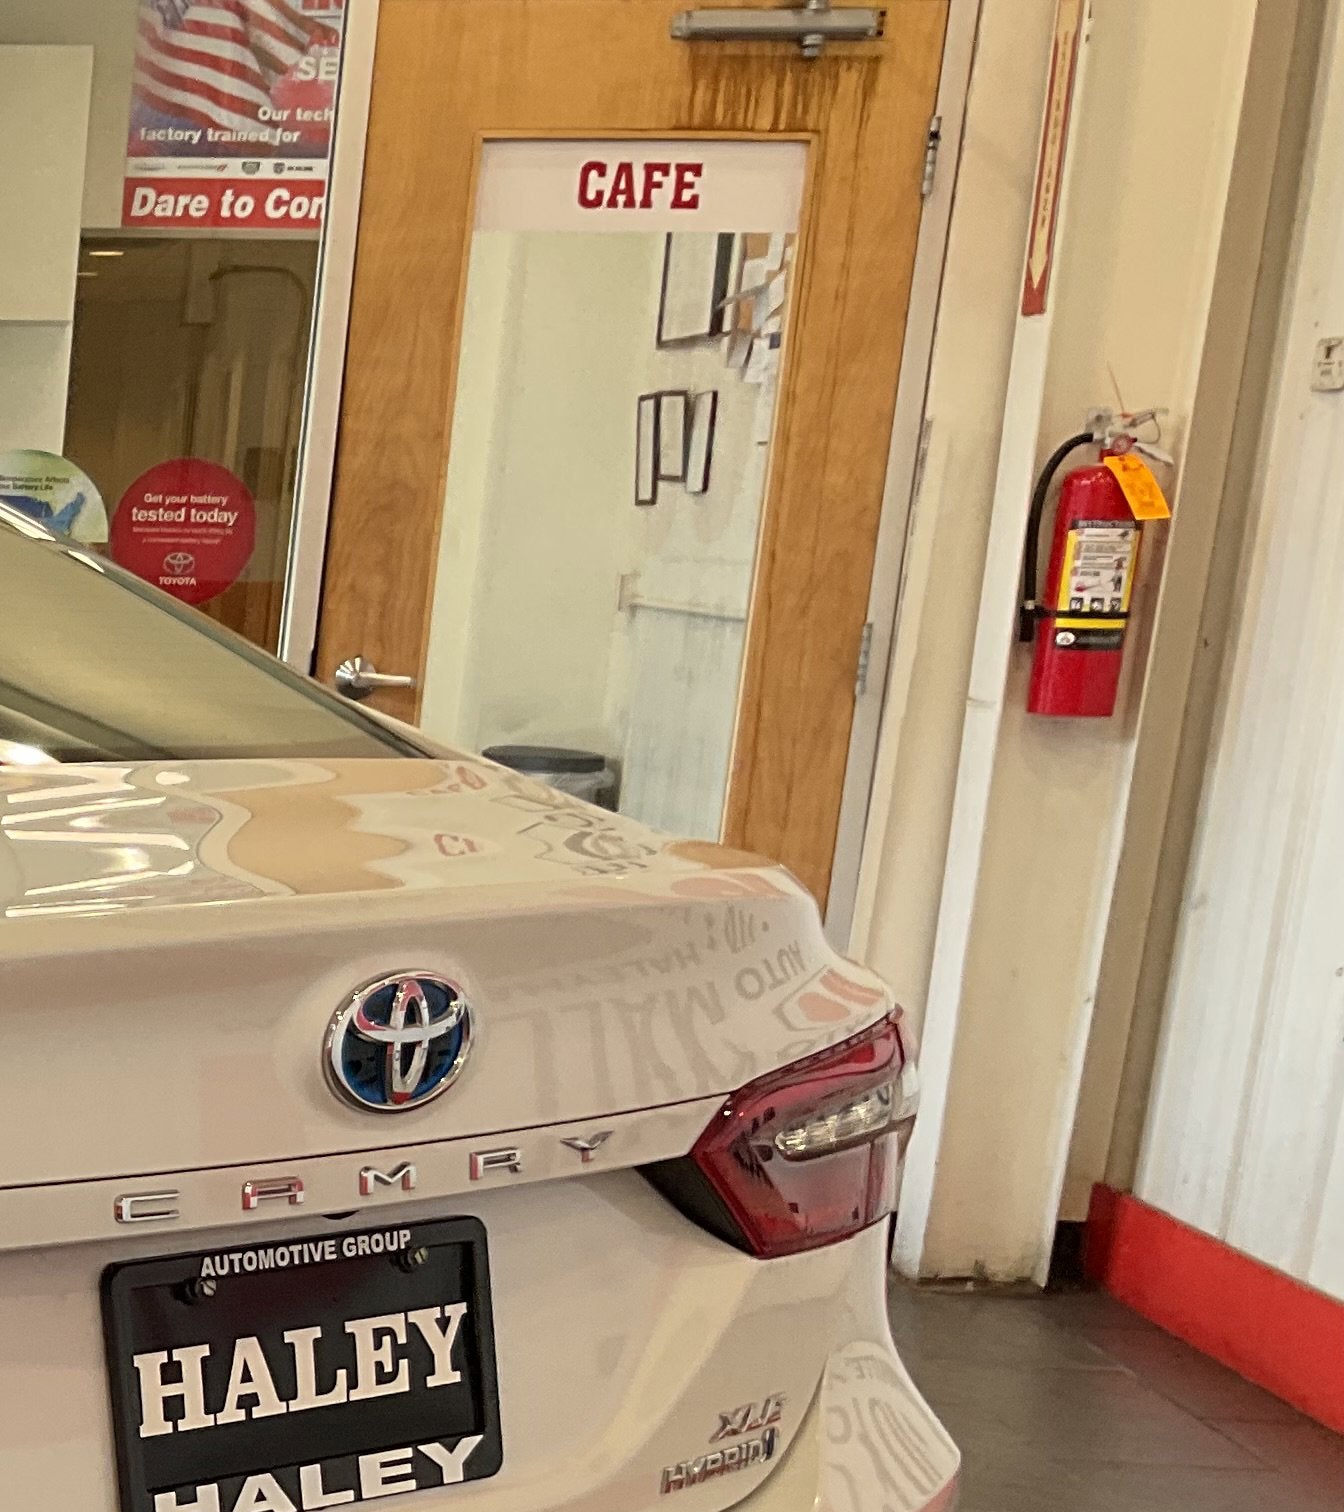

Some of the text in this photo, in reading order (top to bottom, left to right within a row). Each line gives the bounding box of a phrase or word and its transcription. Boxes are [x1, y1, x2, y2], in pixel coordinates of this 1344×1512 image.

[258, 106, 290, 121] Our
[141, 127, 301, 145] factory trained for
[577, 161, 703, 209] CAFE
[130, 187, 209, 218] Dare
[221, 189, 254, 219] to
[144, 493, 228, 507] Get your battery
[132, 507, 238, 526] tested today
[159, 575, 197, 587] TOYOTA
[114, 1130, 614, 1224] CAMRY
[200, 1228, 412, 1278] AUTOMOTIVE GROUP
[133, 1301, 468, 1439] HALEY
